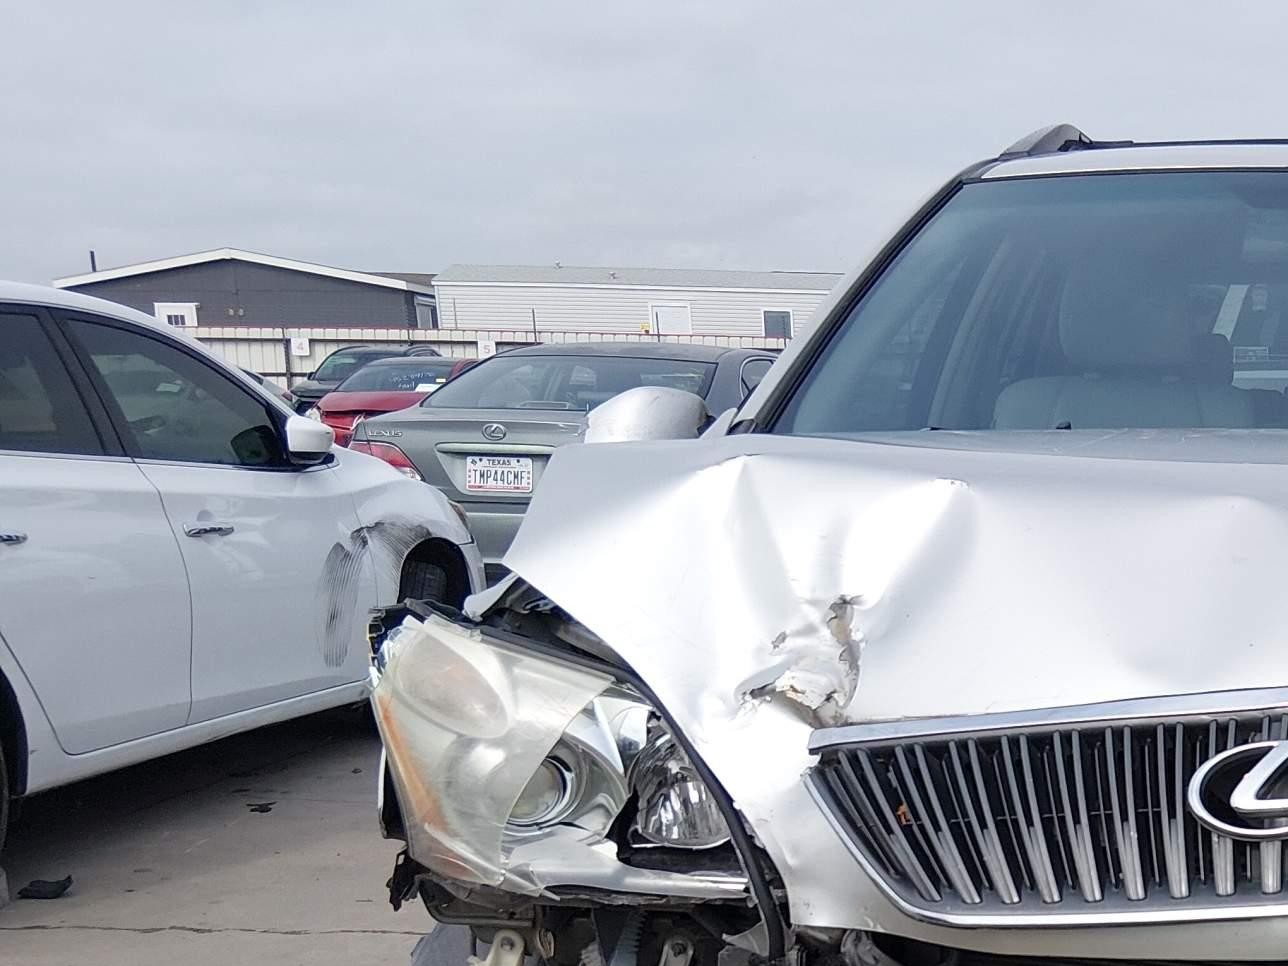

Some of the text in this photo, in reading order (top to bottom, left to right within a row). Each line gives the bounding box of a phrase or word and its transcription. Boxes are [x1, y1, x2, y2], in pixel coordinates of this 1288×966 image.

[483, 344, 491, 353] 5
[368, 430, 403, 438] LEXUS
[486, 458, 512, 466] TEXAS
